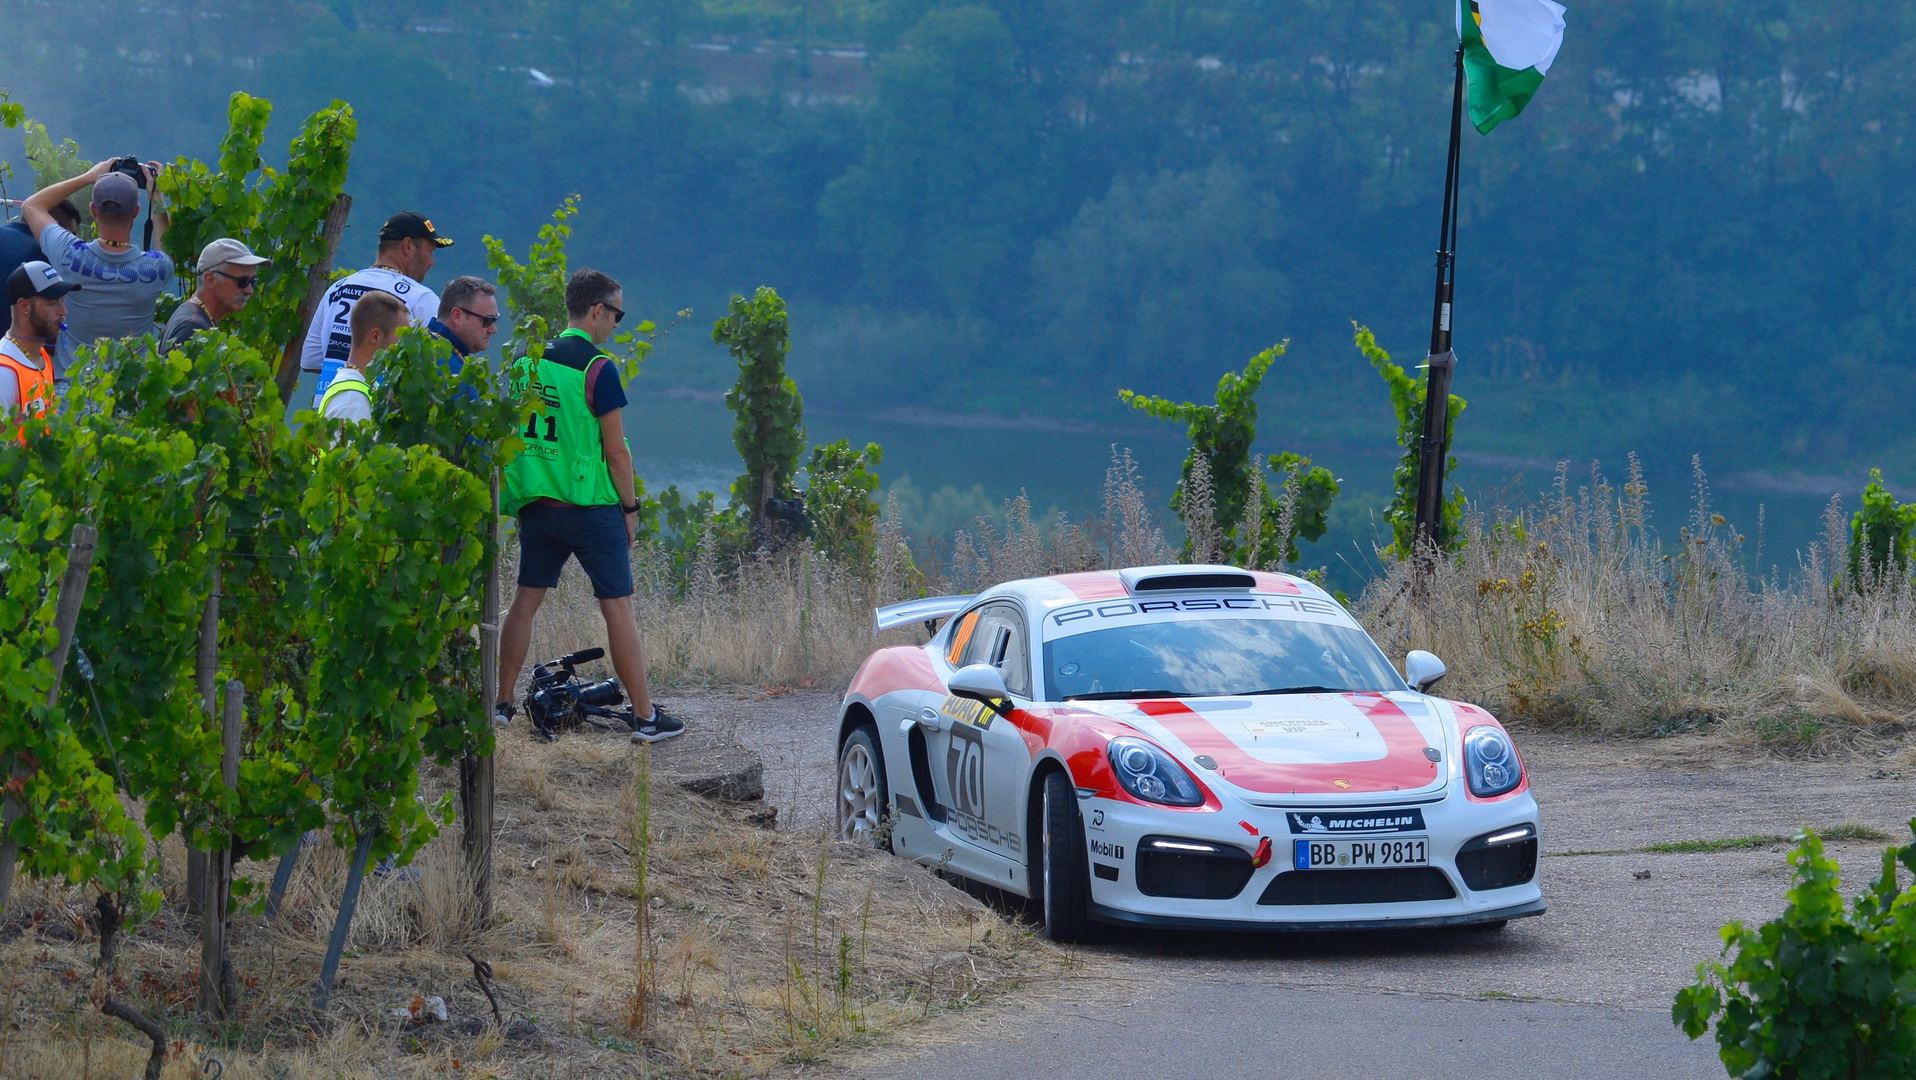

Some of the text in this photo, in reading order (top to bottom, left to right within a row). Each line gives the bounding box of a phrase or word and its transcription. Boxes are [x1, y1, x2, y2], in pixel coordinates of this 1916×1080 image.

[524, 412, 558, 442] 11
[1053, 598, 1337, 626] PORSCHE
[942, 695, 979, 721] ADAC
[952, 736, 983, 818] 70
[946, 808, 1021, 851] PORSCHE
[1329, 816, 1413, 828] MICHELIN
[1091, 839, 1113, 857] Mobil
[1310, 841, 1426, 865] BB PW 9811
